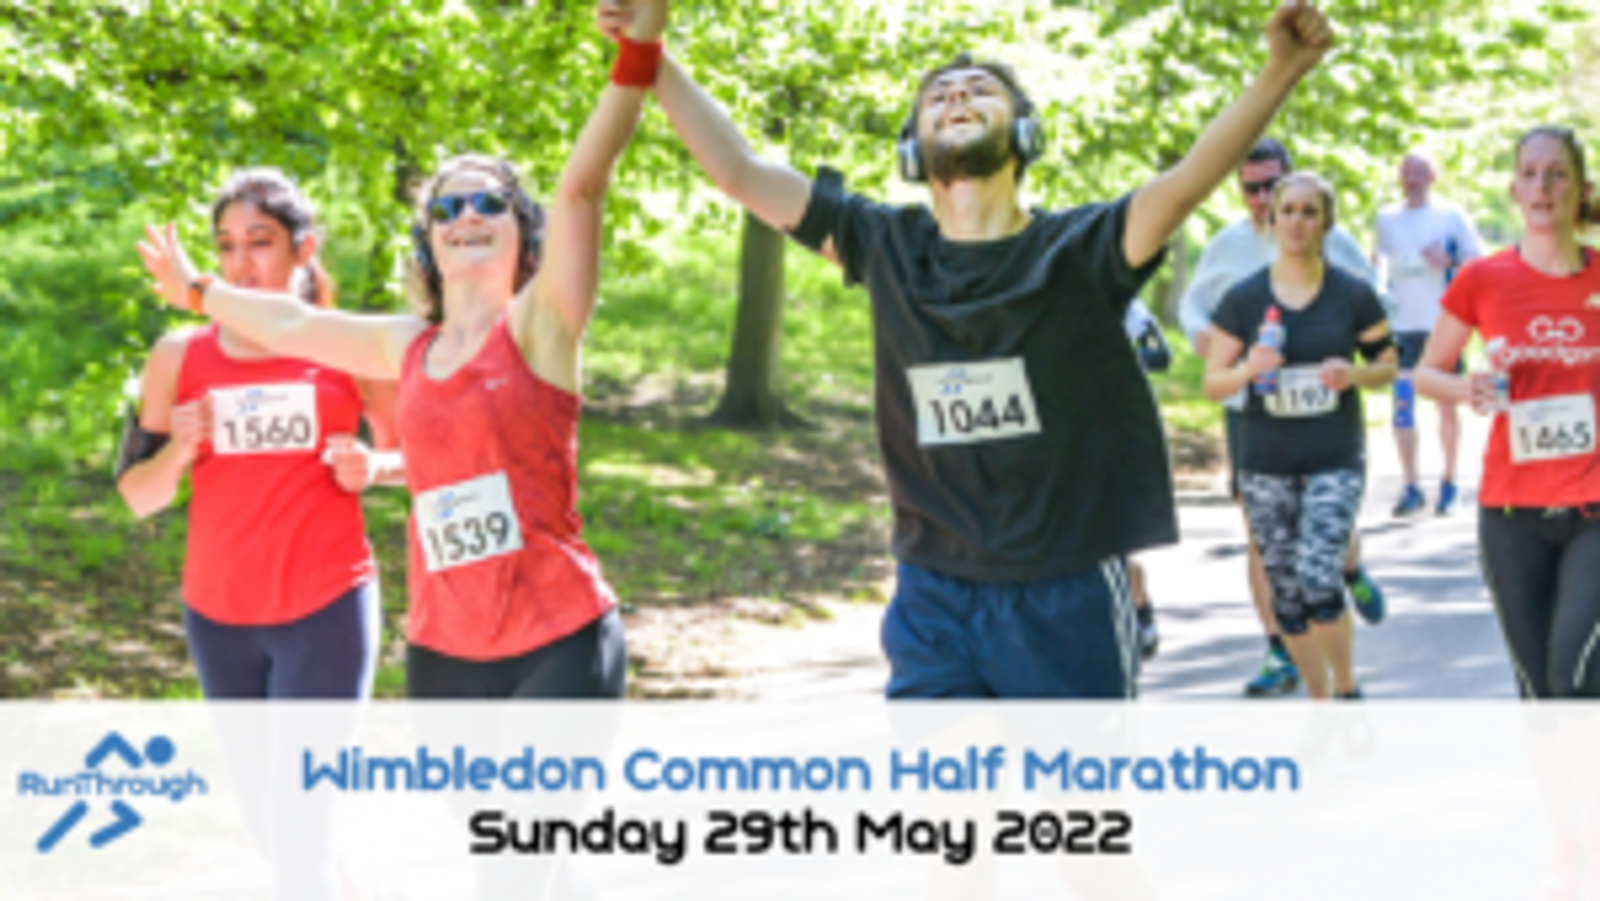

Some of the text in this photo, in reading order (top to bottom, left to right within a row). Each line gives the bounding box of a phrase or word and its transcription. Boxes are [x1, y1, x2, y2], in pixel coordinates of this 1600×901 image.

[222, 413, 313, 449] 1560
[928, 393, 1027, 436] 1044
[1518, 420, 1592, 454] 1465
[426, 510, 512, 564] 1539
